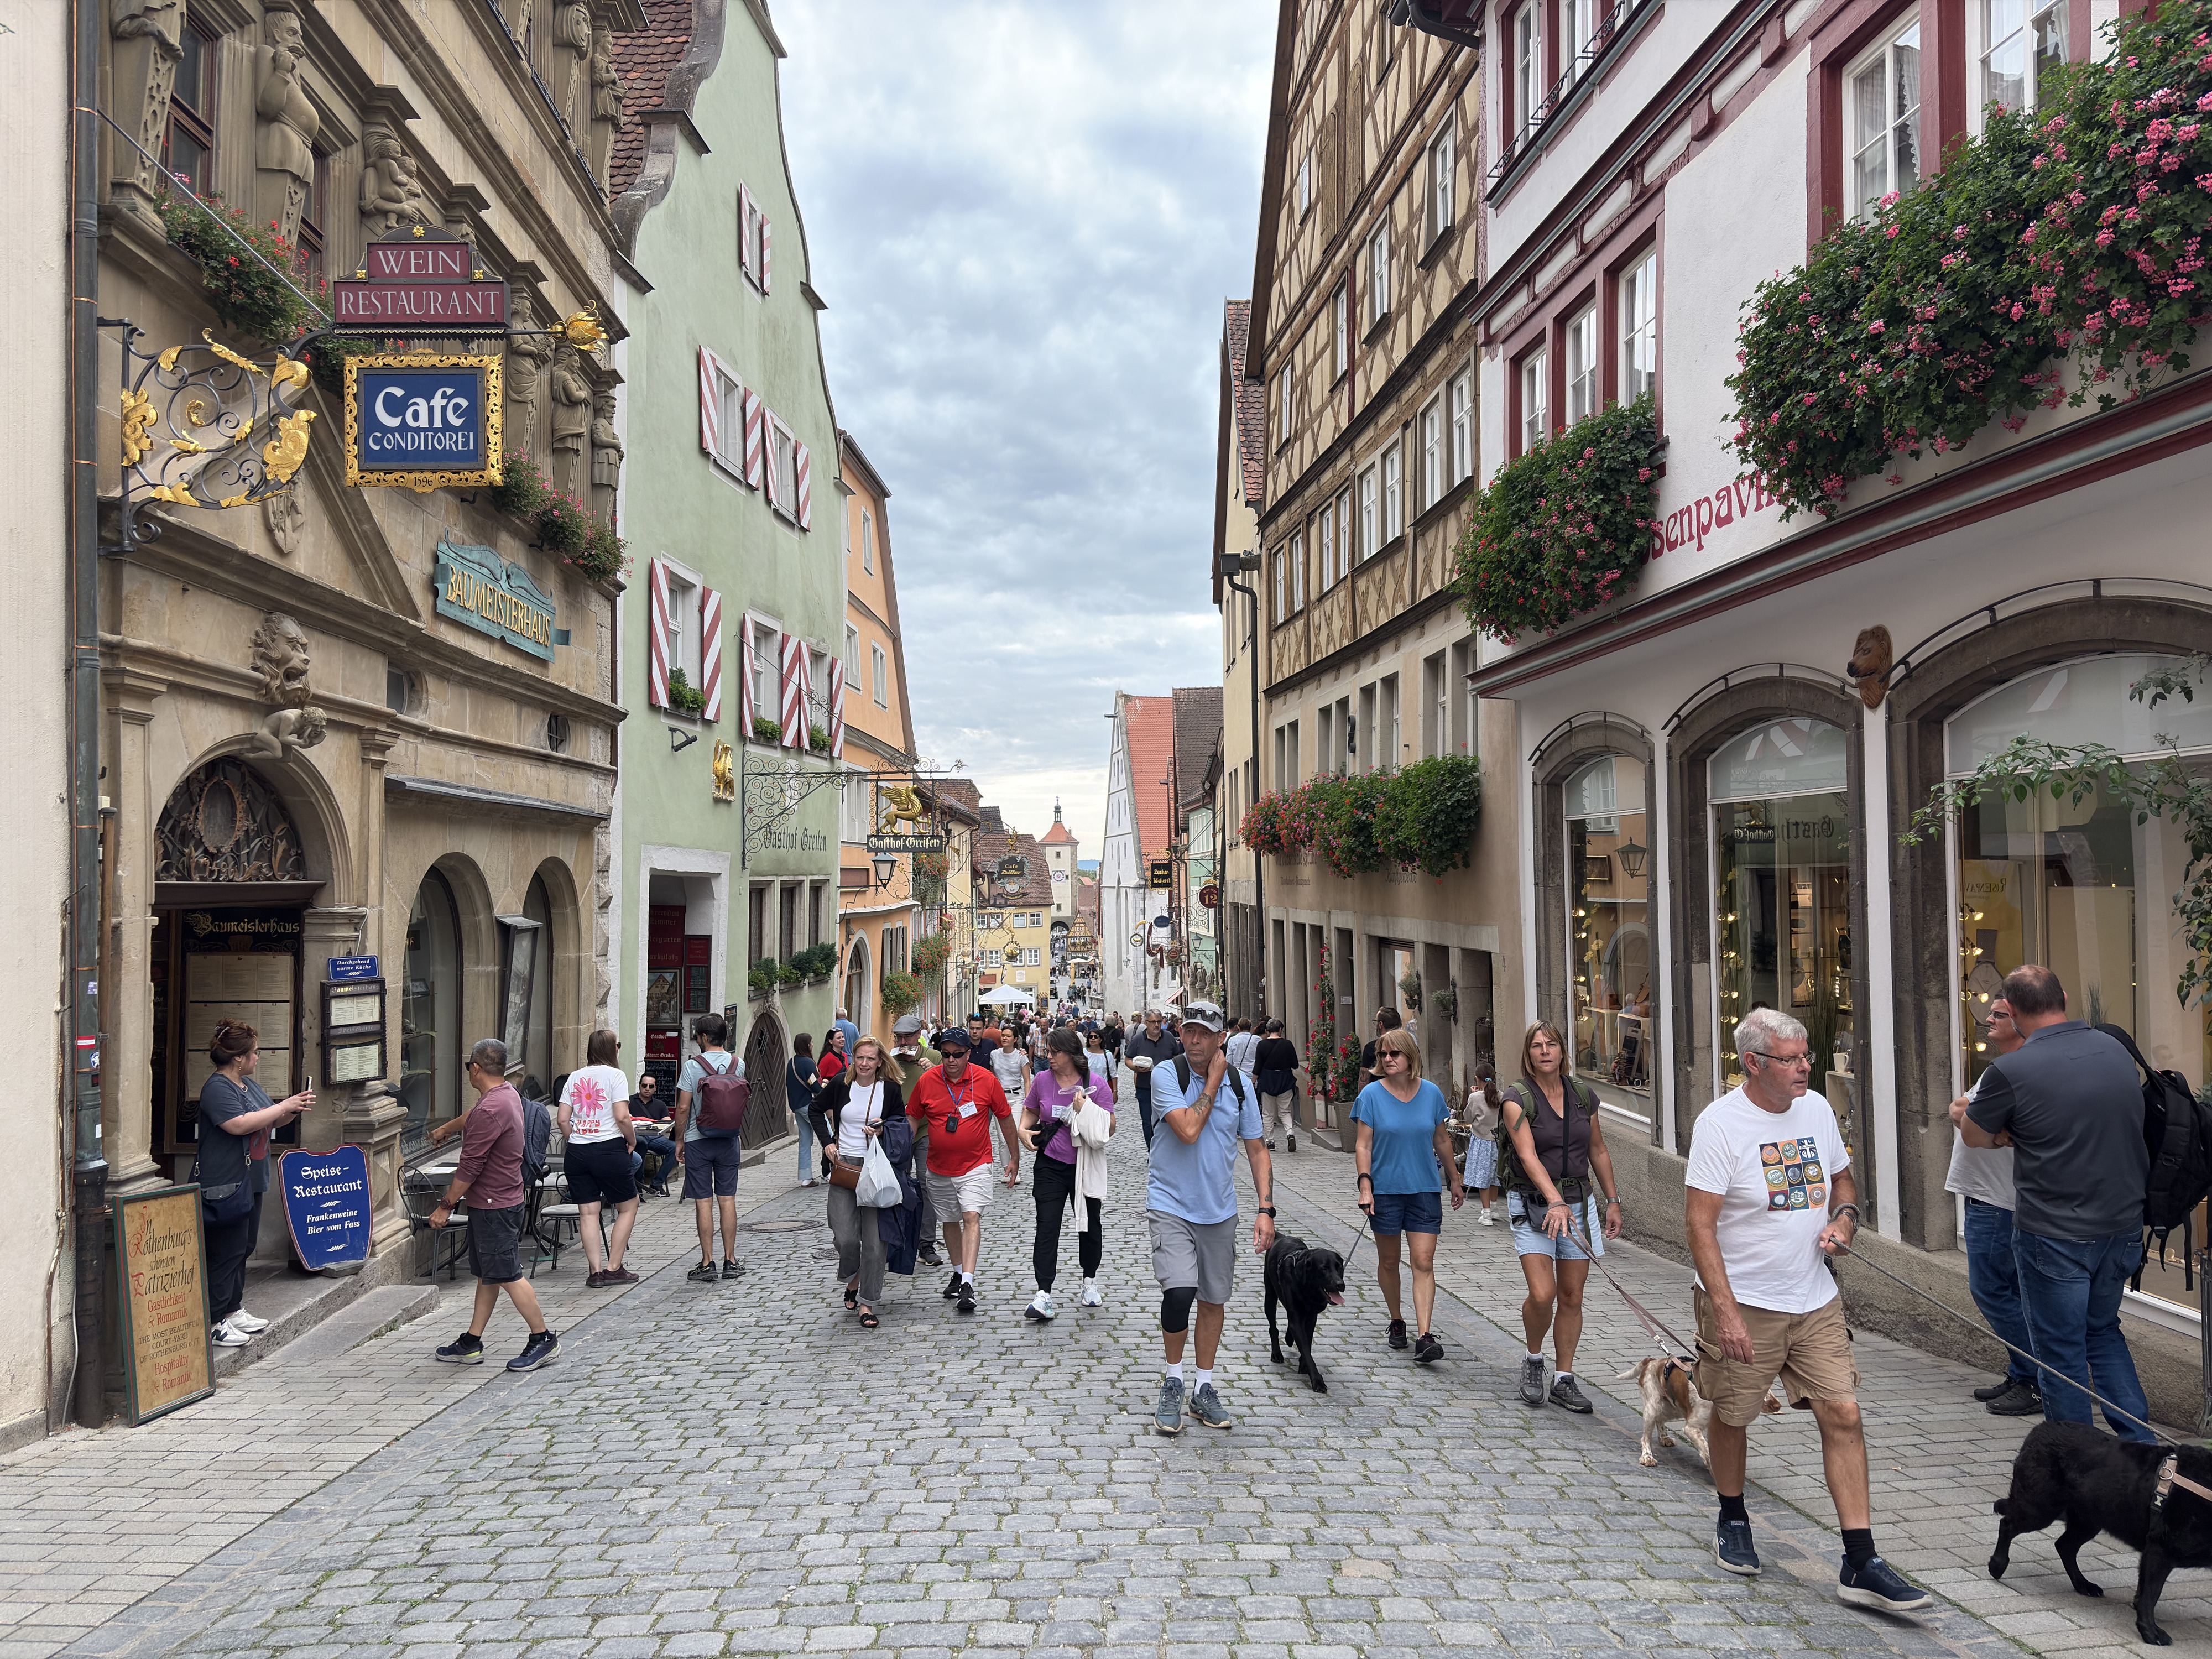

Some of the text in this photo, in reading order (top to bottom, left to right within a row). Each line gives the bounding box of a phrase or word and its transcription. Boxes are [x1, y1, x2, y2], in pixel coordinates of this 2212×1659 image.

[377, 251, 460, 274] WEIN
[341, 291, 499, 315] RESTAURANT
[375, 387, 469, 427] Cafe
[369, 432, 474, 451] CONDITOREI
[413, 476, 433, 487] 1596
[445, 562, 551, 647] BAUMEISTERHAUS
[764, 824, 826, 854] Gasthof Greifen
[906, 836, 940, 849] Greifen
[1204, 894, 1217, 904] 12
[184, 911, 299, 938] Baumeisterhaus
[650, 953, 678, 962] arkplatz
[301, 1165, 349, 1181] Speise-
[293, 1179, 362, 1198] Restaurant
[306, 1209, 358, 1223] Frankenweine
[307, 1226, 324, 1235] Bier
[344, 1220, 360, 1229] Fass
[131, 1258, 197, 1298] Patrizierhof
[148, 1292, 186, 1312] Gastlichkeit
[157, 1305, 188, 1326] Romantik
[139, 1319, 199, 1345] THE MOST BEAUTIFUL
[152, 1332, 188, 1349] COURT-YARD
[139, 1355, 148, 1364] OF
[149, 1344, 187, 1360] ROTHENBURG
[155, 1355, 189, 1376] Hospitality
[162, 1371, 192, 1391] Romantic
